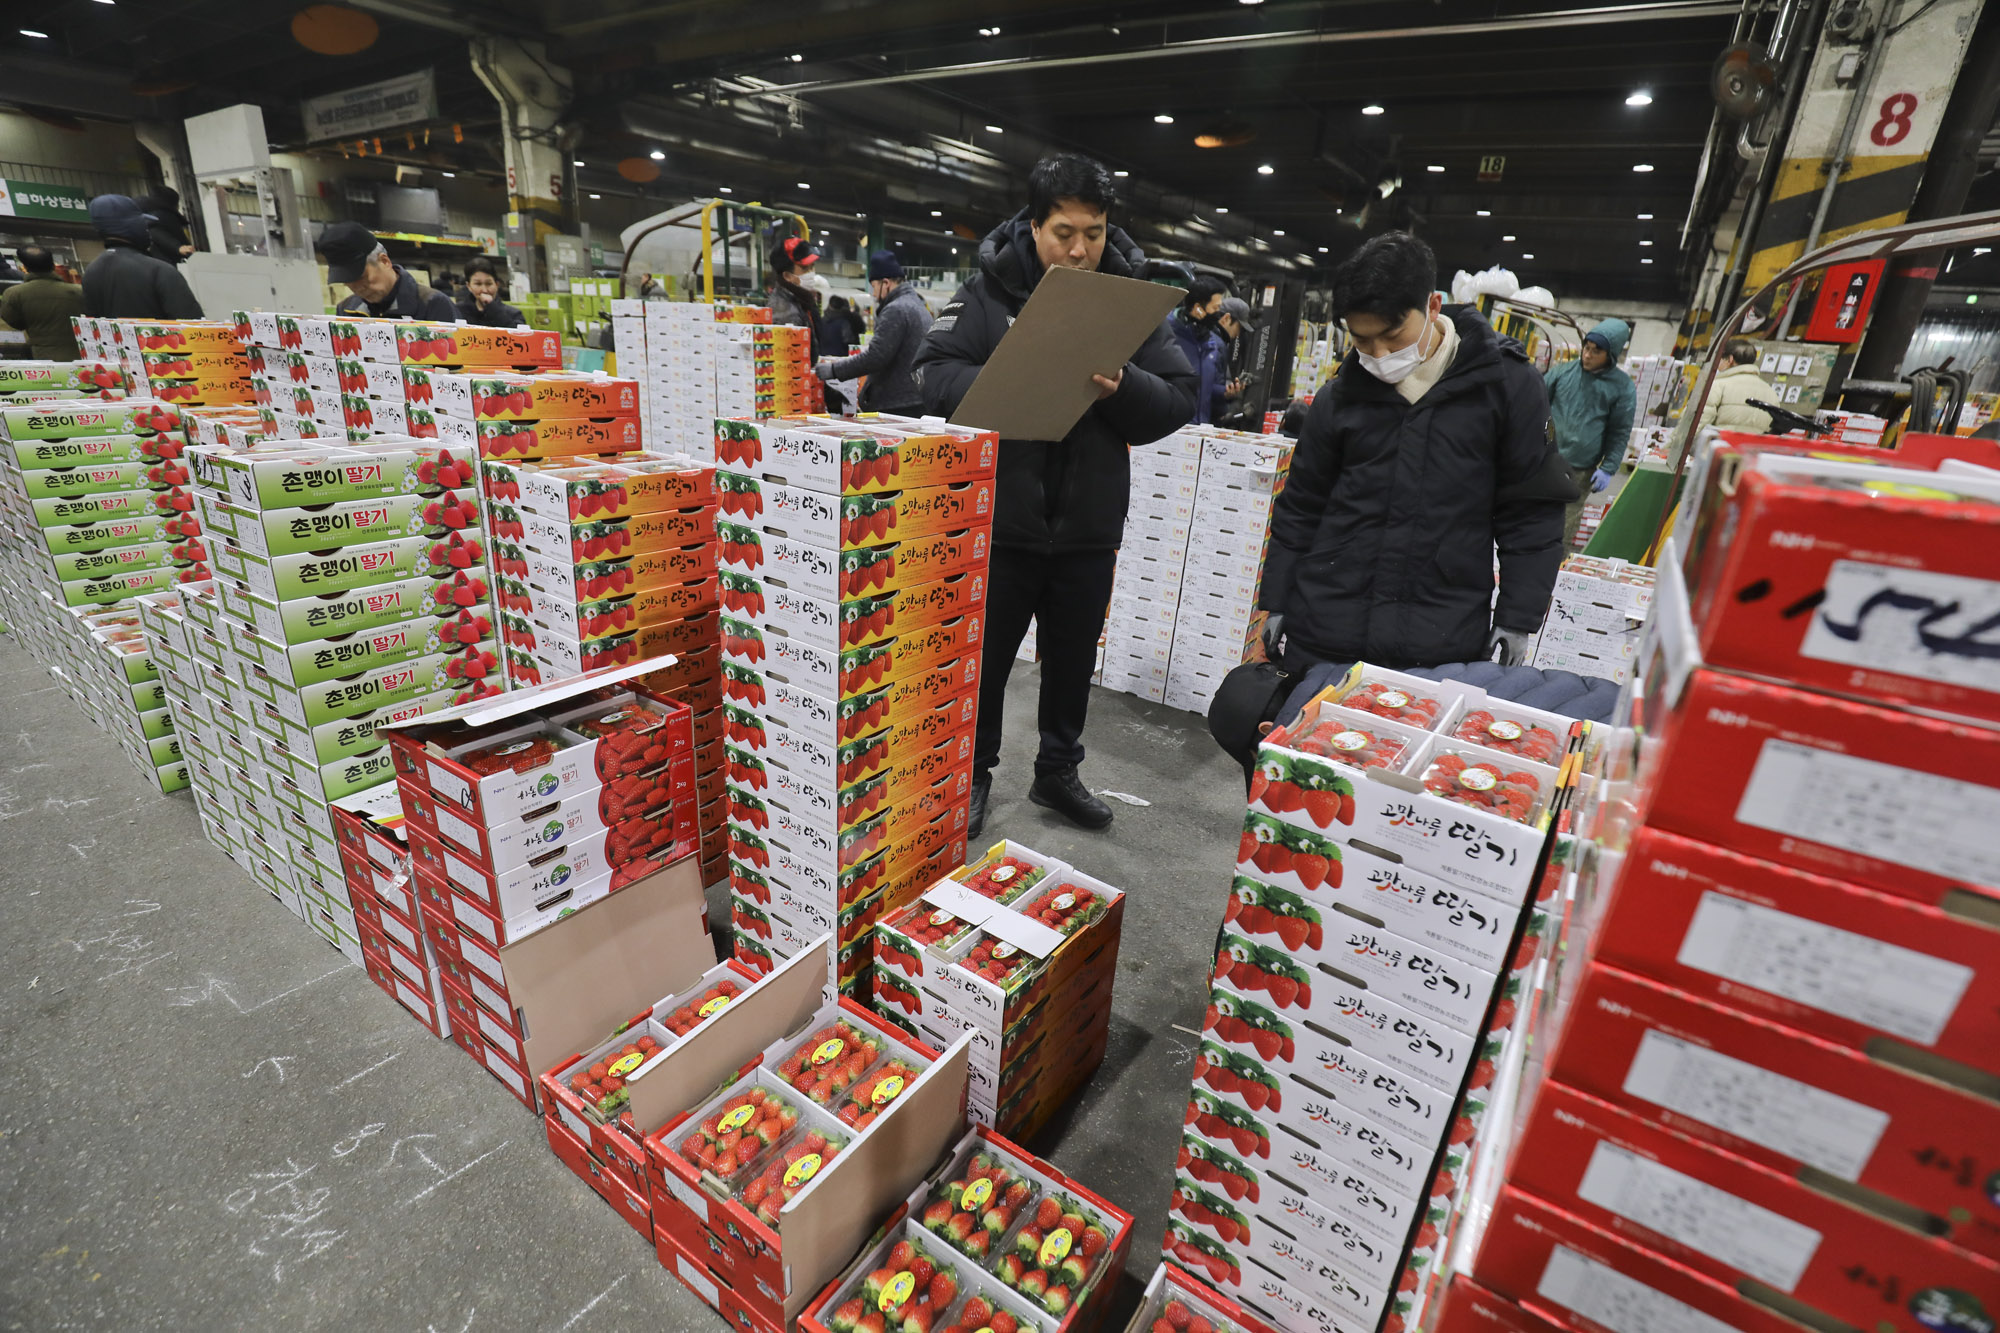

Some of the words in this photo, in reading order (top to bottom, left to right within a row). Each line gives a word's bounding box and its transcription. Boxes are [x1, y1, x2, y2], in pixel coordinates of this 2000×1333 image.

[1870, 92, 1918, 147] 8
[1484, 157, 1502, 171] 18
[508, 167, 516, 189] 5
[550, 174, 562, 196] 5
[15, 191, 88, 210] 출하상담실
[495, 335, 529, 356] 딸기
[1256, 325, 1271, 370] TOYOTA
[24, 370, 52, 380] 딸기
[572, 388, 606, 408] 딸기
[27, 415, 75, 430] 촌맹이
[76, 414, 105, 426] 딸기
[576, 425, 609, 444] 딸기
[35, 444, 82, 460] 촌맹이
[84, 442, 113, 455] 딸기
[802, 439, 834, 465] 딸기
[937, 442, 969, 469] 딸기
[44, 472, 91, 489] 촌맹이
[92, 470, 120, 482] 딸기
[281, 468, 343, 493] 촌맹이
[345, 465, 382, 484] 딸기
[664, 477, 698, 497] 딸기
[53, 500, 100, 517] 촌맹이
[100, 498, 128, 510] 딸기
[802, 495, 834, 521] 딸기
[933, 494, 965, 519] 딸기
[65, 528, 110, 544] 촌맹이
[111, 525, 139, 537] 딸기
[290, 513, 350, 539] 촌맹이
[353, 508, 389, 527] 딸기
[667, 517, 700, 537] 딸기
[74, 554, 119, 571] 촌맹이
[119, 550, 146, 563] 딸기
[669, 553, 702, 573] 딸기
[802, 548, 834, 575] 딸기
[931, 540, 962, 565] 딸기
[298, 556, 359, 584] 촌맹이
[360, 551, 396, 571] 딸기
[83, 580, 127, 597] 촌맹이
[127, 576, 154, 588] 딸기
[670, 588, 702, 609] 딸기
[930, 586, 959, 610] 딸기
[306, 599, 365, 627] 촌맹이
[366, 592, 401, 612] 딸기
[803, 602, 833, 626] 딸기
[672, 625, 704, 643] 딸기
[927, 631, 956, 654] 딸기
[314, 640, 370, 669] 촌맹이
[372, 632, 406, 653] 딸기
[803, 649, 833, 674] 딸기
[324, 678, 380, 709] 촌맹이
[382, 669, 415, 691] 딸기
[924, 675, 953, 698] 딸기
[802, 696, 831, 722] 딸기
[922, 714, 951, 735] 딸기
[803, 741, 831, 767] 딸기
[920, 753, 948, 775] 딸기
[562, 769, 578, 783] 딸기
[803, 786, 832, 810] 딸기
[919, 789, 947, 812] 딸기
[566, 815, 583, 828] 딸기
[804, 827, 832, 851] 딸기
[917, 826, 944, 847] 딸기
[1380, 803, 1442, 837] 고맛나루
[1448, 821, 1517, 866] 딸기
[573, 858, 590, 872] 딸기
[915, 863, 942, 883] 딸기
[804, 867, 832, 891] 딸기
[1367, 869, 1427, 898] 고맛나루
[1433, 889, 1498, 935] 딸기
[804, 904, 832, 929] 딸기
[1345, 932, 1402, 967] 고맛나루
[1408, 954, 1471, 1000] 딸기
[964, 981, 997, 1011] 딸기
[1333, 995, 1388, 1028] 고맛나루
[1393, 1018, 1454, 1064] 딸기
[1316, 1050, 1368, 1084] 고맛나루
[1373, 1074, 1432, 1119] 딸기
[1302, 1102, 1352, 1136] 고맛나루
[1357, 1127, 1413, 1171] 딸기
[1290, 1150, 1339, 1184] 고맛나루
[1343, 1175, 1398, 1219] 딸기
[1279, 1195, 1326, 1229] 고맛나루
[1330, 1221, 1383, 1263] 딸기
[1269, 1239, 1314, 1273] 고맛나루
[1319, 1264, 1369, 1308] 딸기
[1259, 1280, 1303, 1312] 고맛나루
